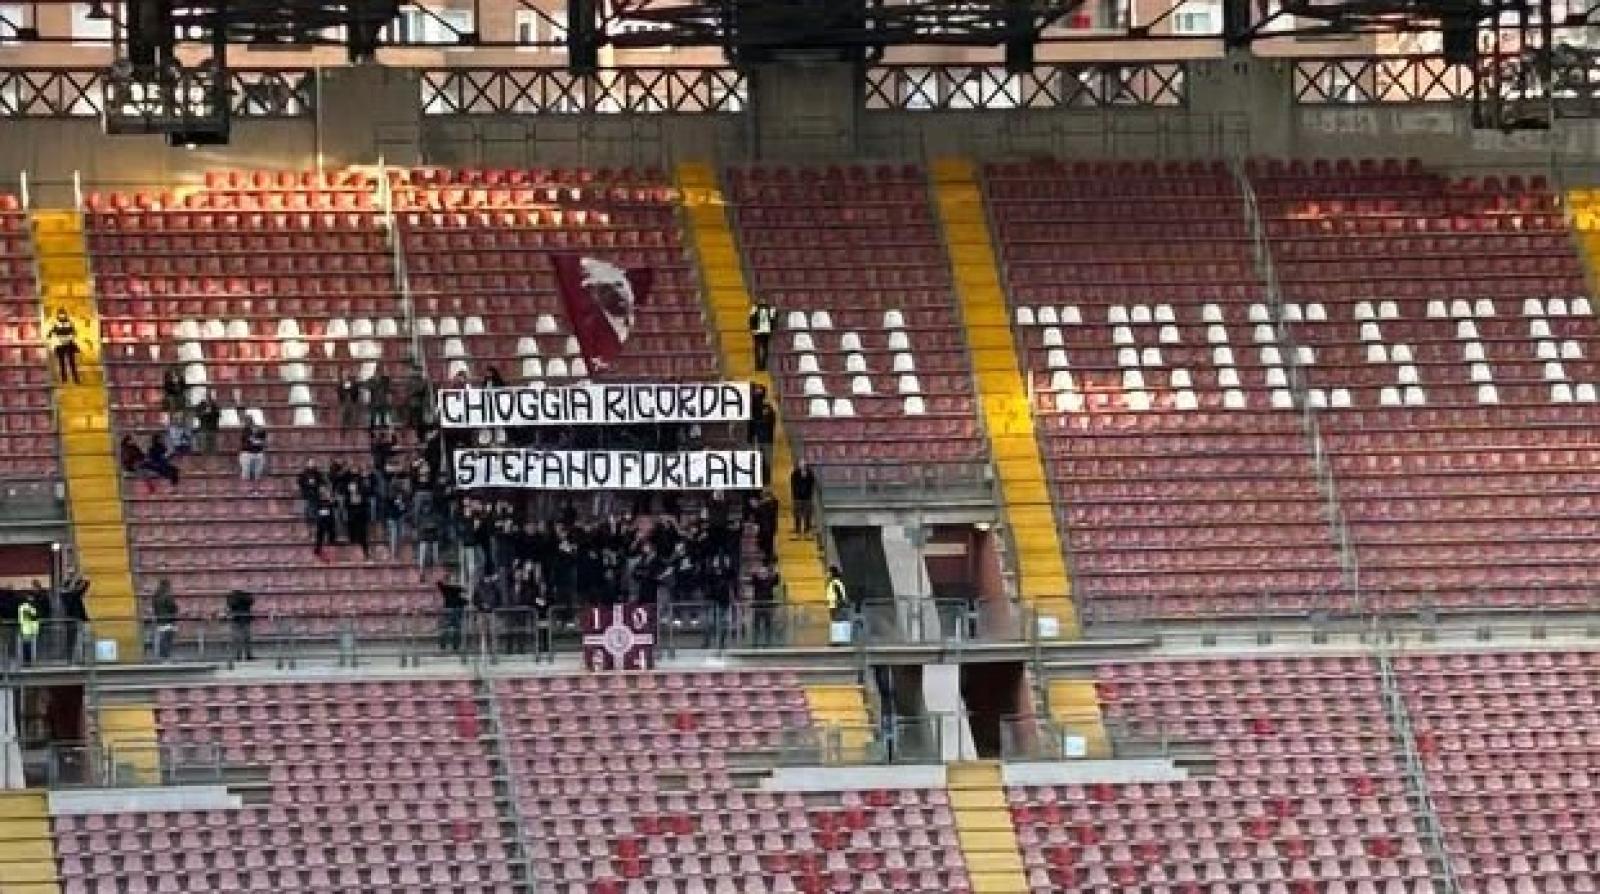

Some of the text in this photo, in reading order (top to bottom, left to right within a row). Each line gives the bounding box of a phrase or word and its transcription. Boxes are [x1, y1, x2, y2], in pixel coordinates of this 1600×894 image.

[1017, 298, 1597, 412] TRIESTE
[444, 385, 743, 423] CHIOGGIA RICORDA
[457, 451, 756, 488] STEFANO FURLAN
